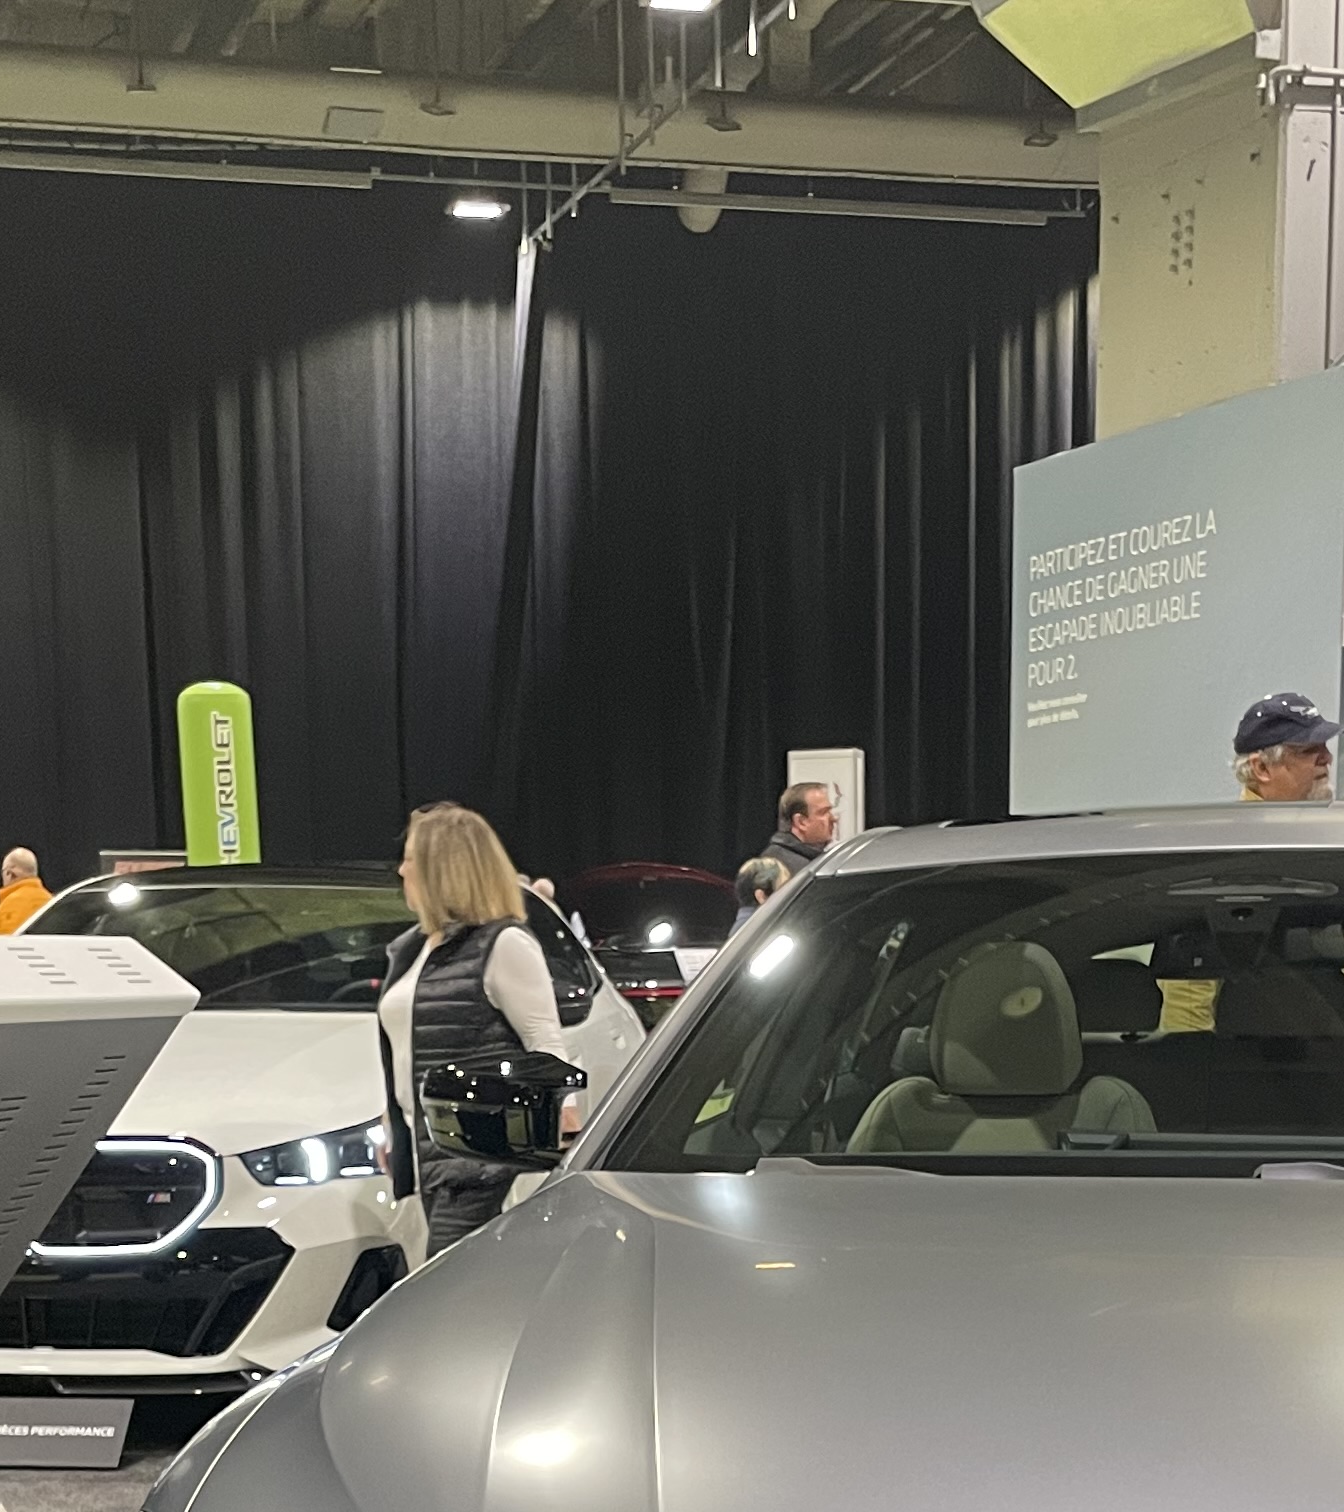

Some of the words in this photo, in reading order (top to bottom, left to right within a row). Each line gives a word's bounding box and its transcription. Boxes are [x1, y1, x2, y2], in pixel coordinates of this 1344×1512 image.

[1029, 537, 1106, 581] PARTICIPEZ
[1108, 532, 1127, 561] ET
[1129, 515, 1192, 557] COUREZ
[1195, 508, 1217, 539] LA
[1029, 580, 1083, 618] CHANCE
[1085, 575, 1105, 604] DE
[1107, 561, 1170, 598] GAGNER
[1173, 551, 1207, 582] UNE
[1029, 614, 1097, 653] ESCAPADE
[1100, 591, 1201, 637] INOUBLIABLE
[1028, 657, 1065, 687] POUR
[1066, 655, 1078, 680] 2.
[212, 711, 240, 865] HEVROLET
[31, 1425, 115, 1437] PERFORMANCE
